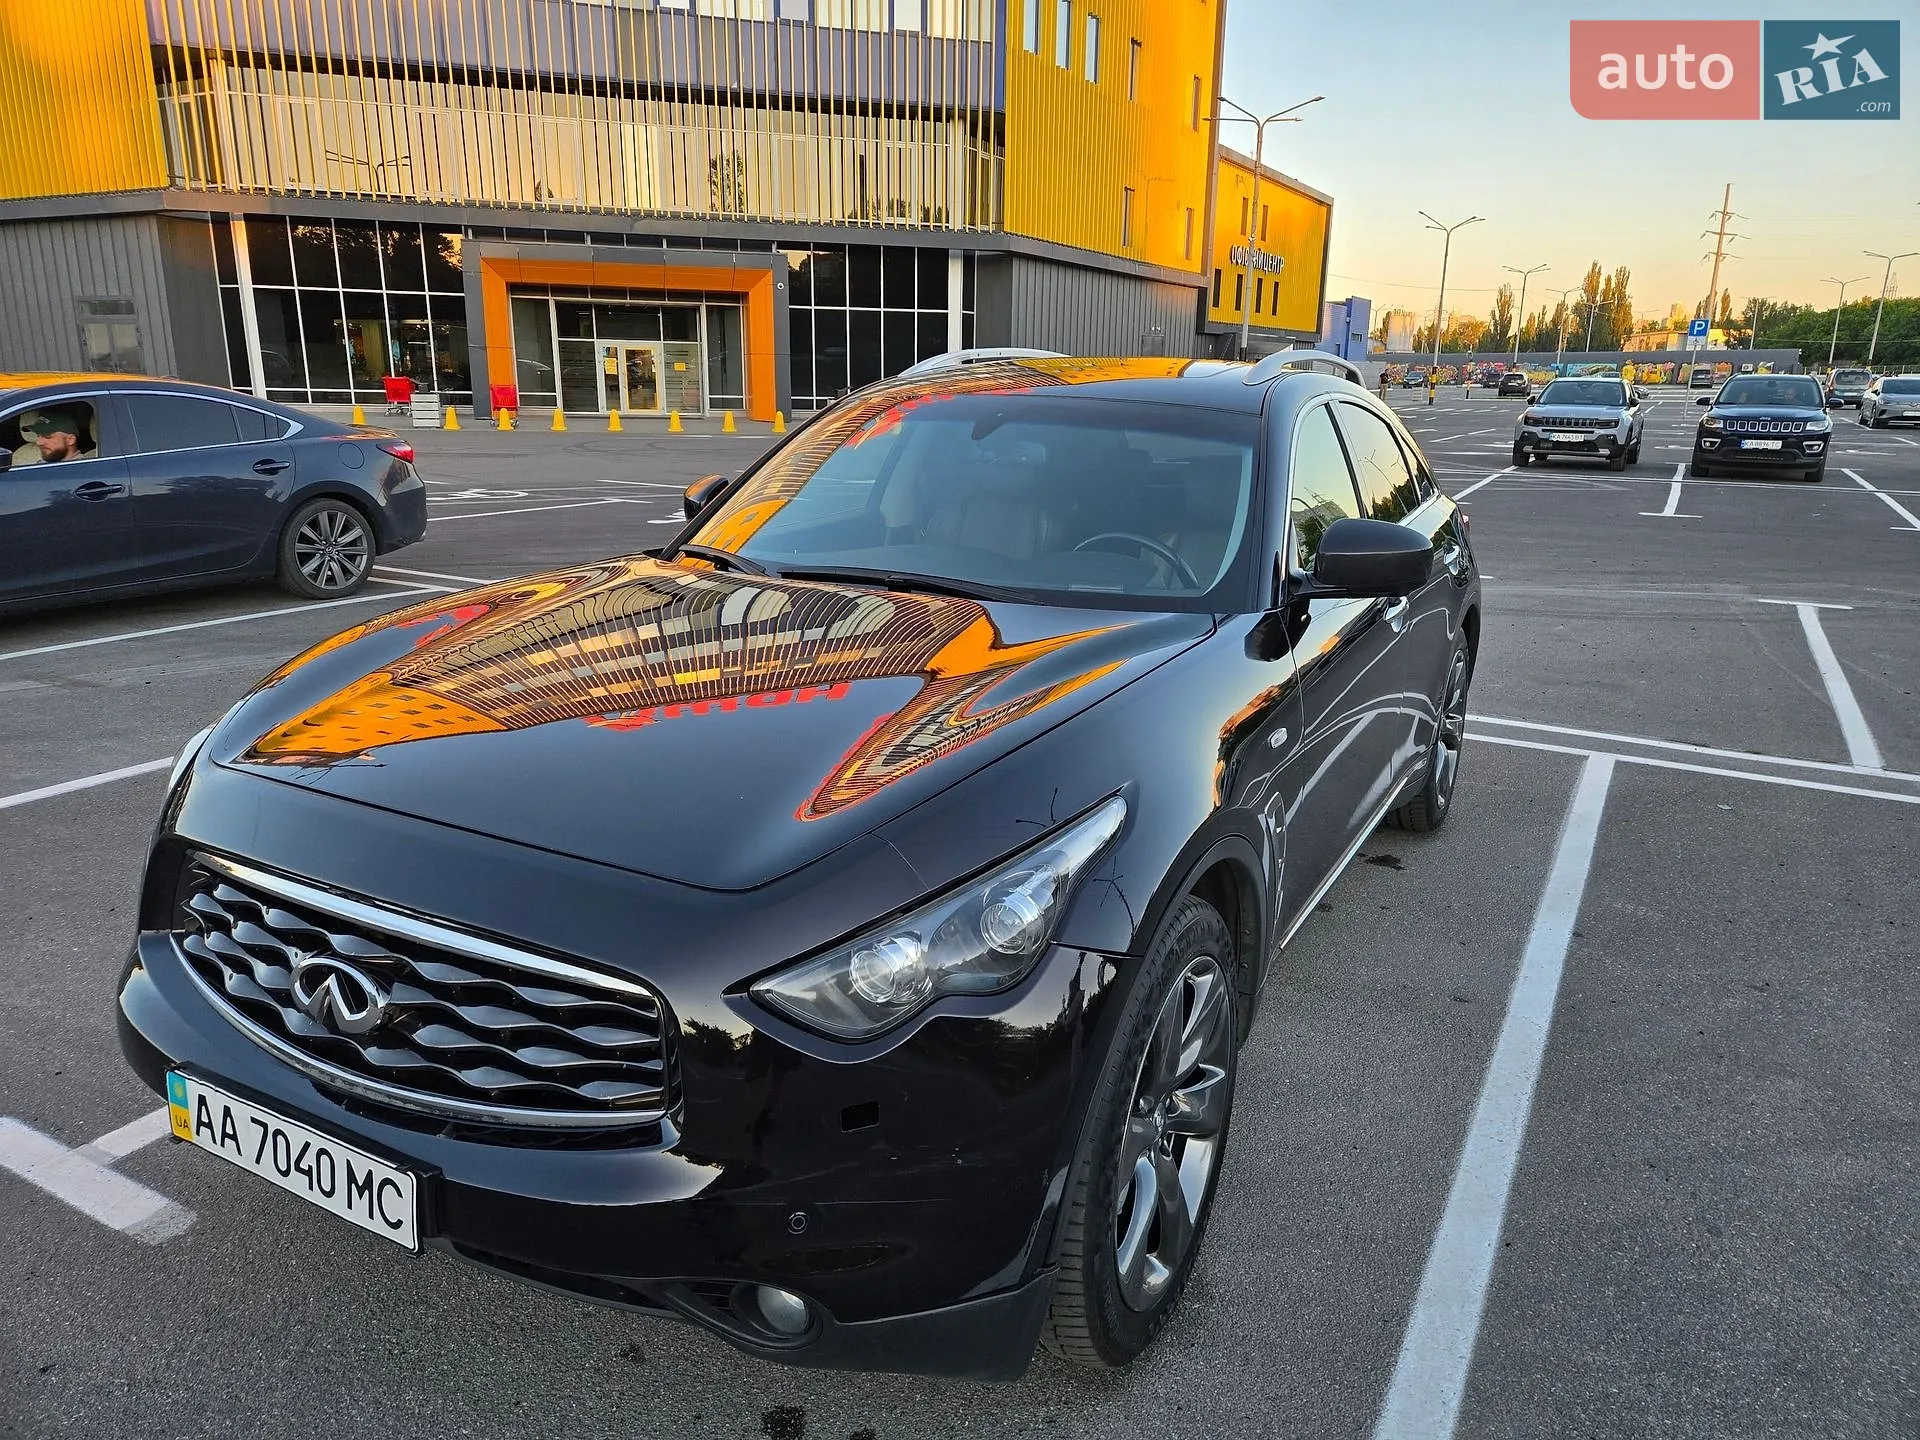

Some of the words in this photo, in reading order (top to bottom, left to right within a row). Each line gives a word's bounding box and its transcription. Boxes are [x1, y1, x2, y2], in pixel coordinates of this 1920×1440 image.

[1694, 321, 1705, 335] P
[174, 1116, 191, 1132] UA
[195, 1093, 243, 1157] AA
[250, 1115, 336, 1199] 7040
[345, 1158, 405, 1231] MC
